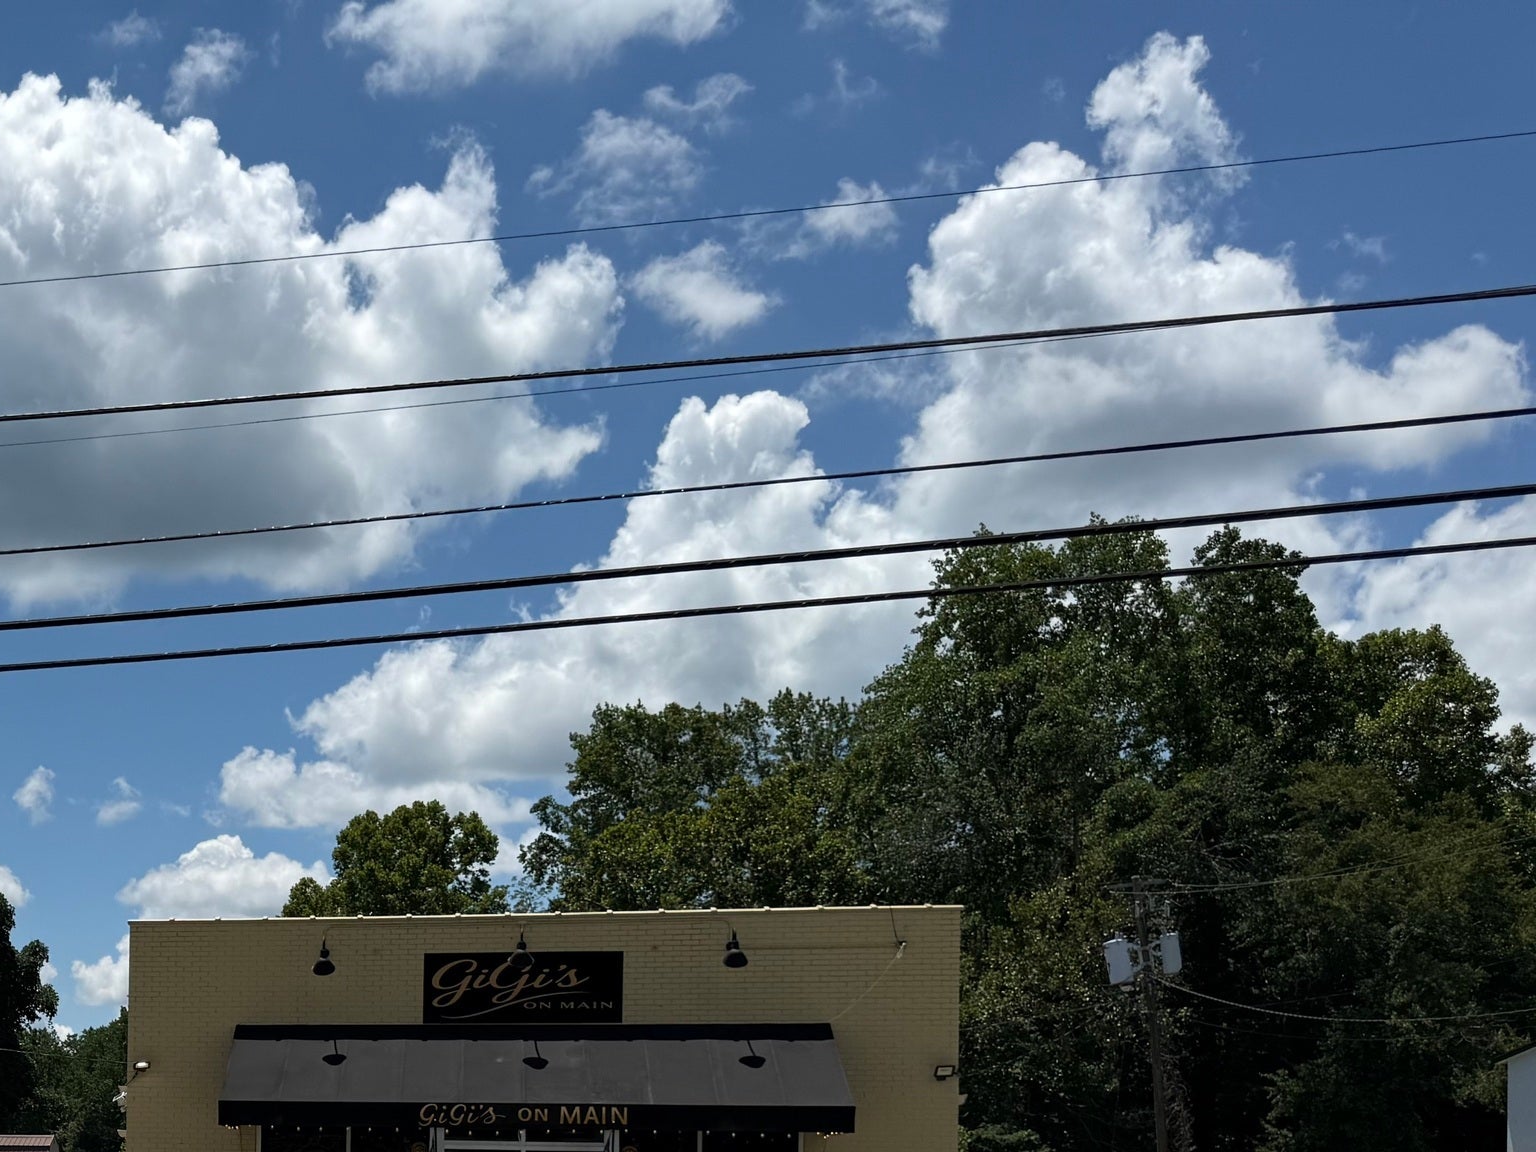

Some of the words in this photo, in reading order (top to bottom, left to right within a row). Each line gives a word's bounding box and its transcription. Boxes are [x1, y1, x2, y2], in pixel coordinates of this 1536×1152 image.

[523, 1001, 551, 1009] ON
[560, 1001, 613, 1009] MAIN
[518, 1107, 549, 1121] ON
[559, 1105, 629, 1126] MAIN
